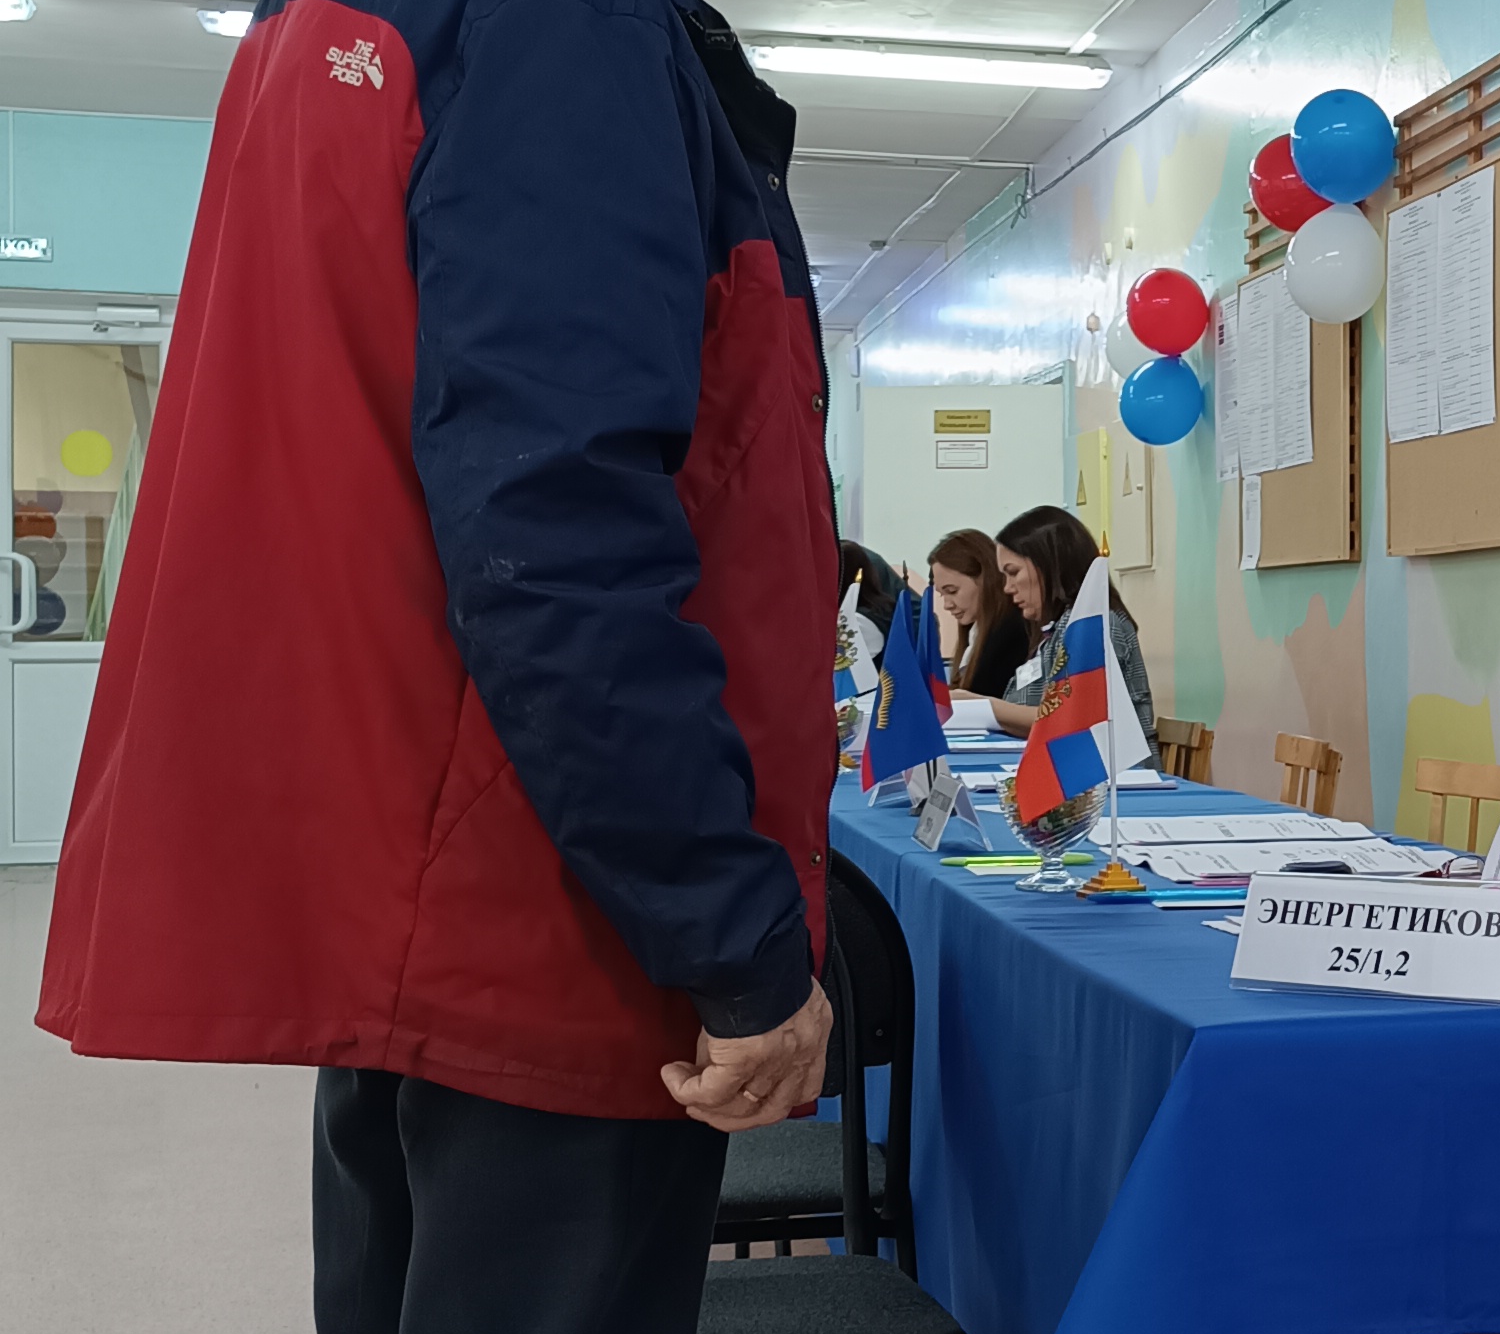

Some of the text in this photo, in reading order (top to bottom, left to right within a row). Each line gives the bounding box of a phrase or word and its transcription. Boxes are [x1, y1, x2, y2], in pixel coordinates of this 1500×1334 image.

[325, 46, 370, 72] SUPER
[353, 38, 375, 58] THE
[1327, 946, 1411, 981] 25/1,2
